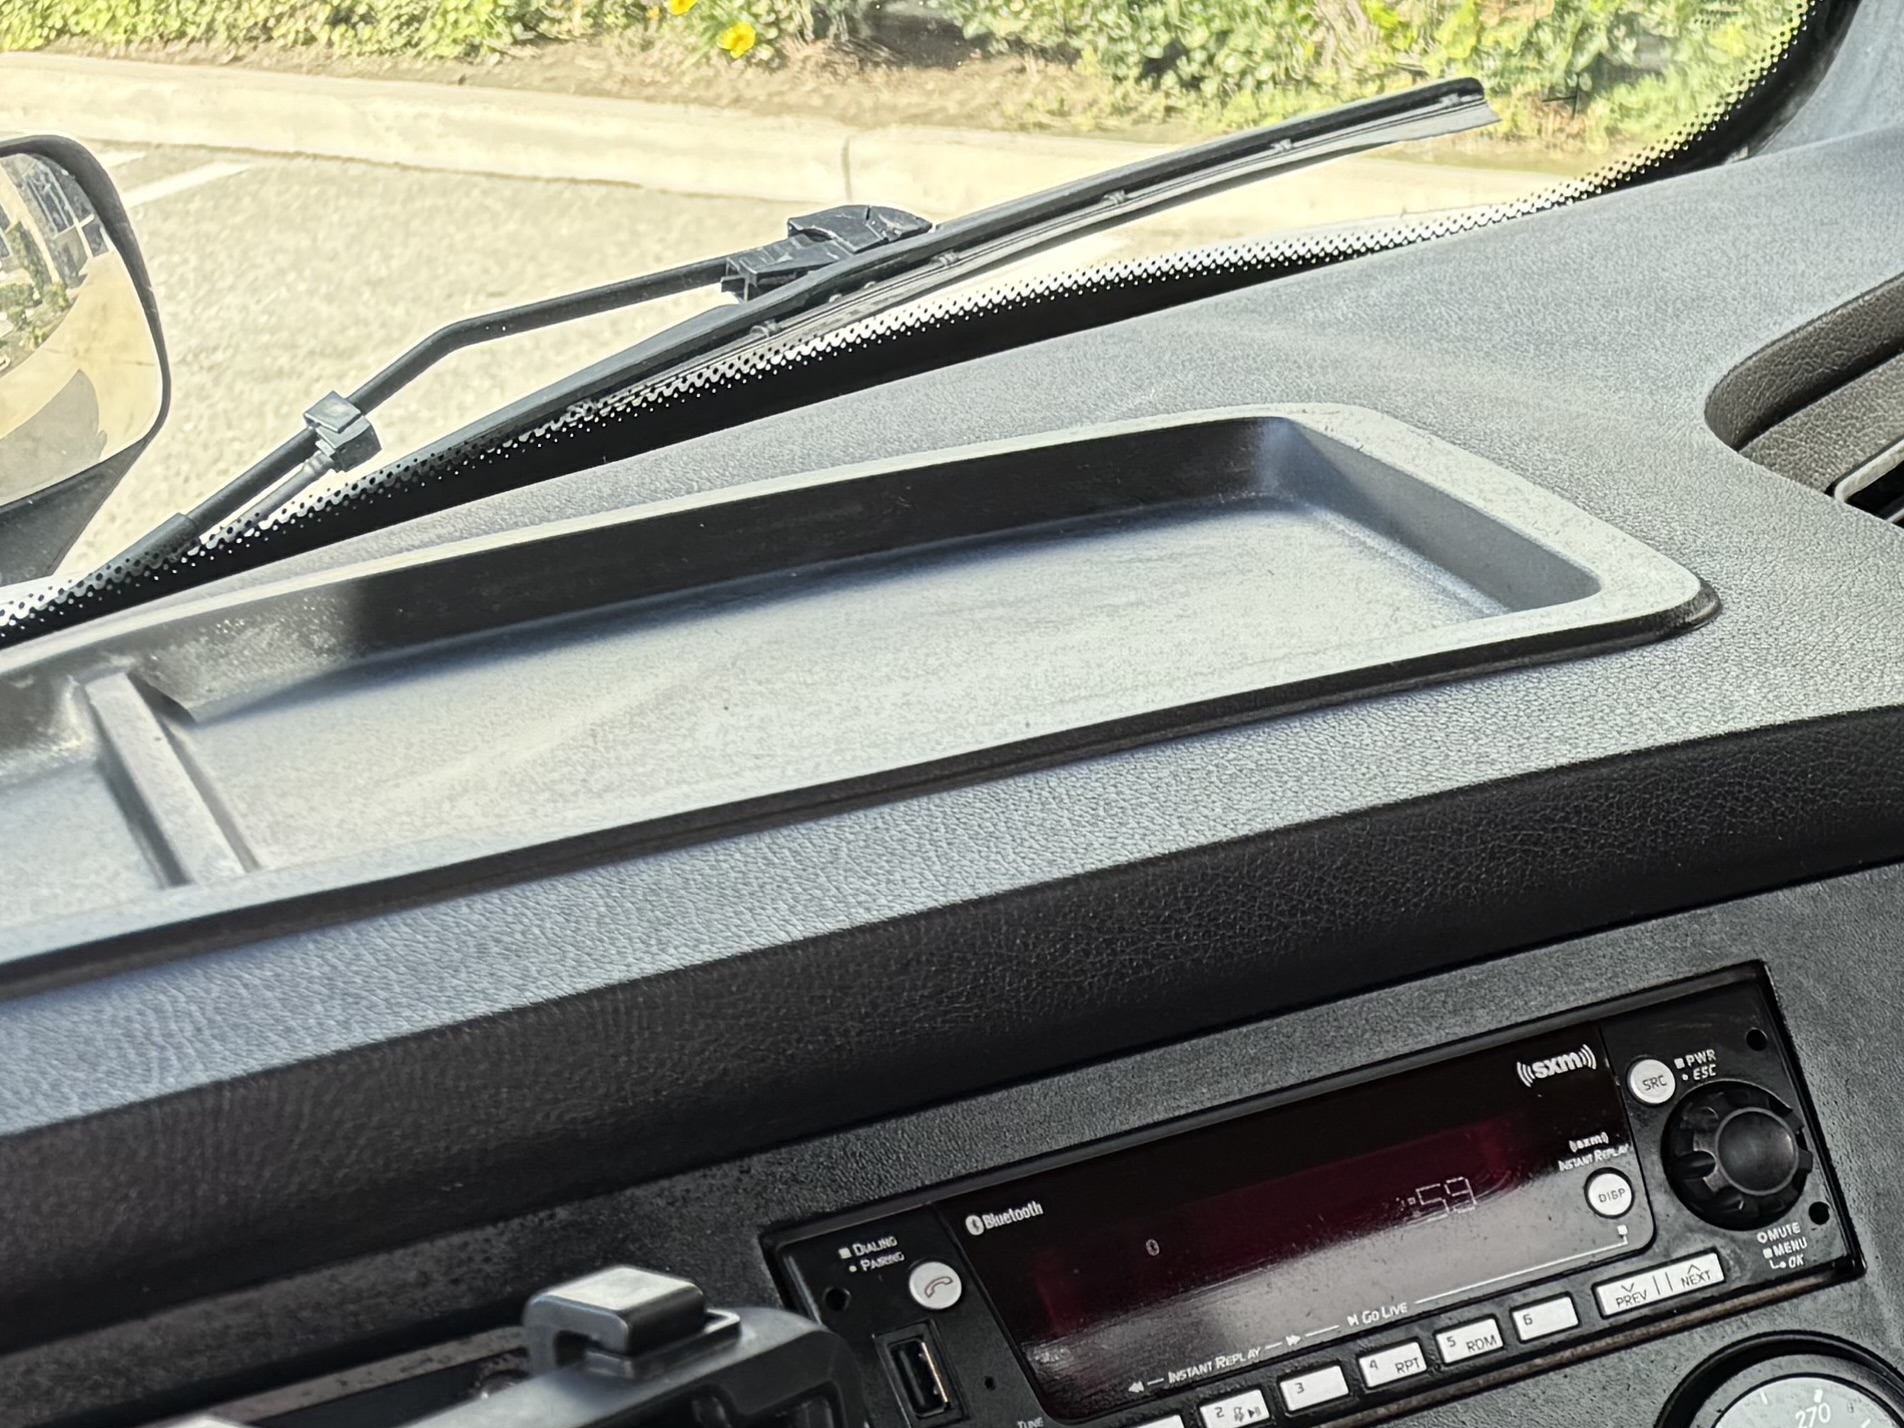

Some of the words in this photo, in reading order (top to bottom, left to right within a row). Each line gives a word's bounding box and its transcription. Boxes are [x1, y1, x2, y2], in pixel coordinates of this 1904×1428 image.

[1686, 1048, 1717, 1068] PWR
[1692, 1063, 1717, 1081] ESC
[1642, 1073, 1668, 1092] SRC
[982, 1200, 1044, 1231] Bluetooth
[1767, 1221, 1802, 1241] MUTE
[1773, 1237, 1808, 1257] MENU
[1788, 1254, 1805, 1269] OK
[1680, 1268, 1712, 1288] NEXT
[1616, 1290, 1648, 1309] PREV
[1522, 1313, 1533, 1327] 6
[1446, 1335, 1457, 1348] 5
[1464, 1334, 1498, 1354] RDM
[1368, 1359, 1379, 1372] 4
[1393, 1355, 1423, 1376] RPT
[1295, 1382, 1306, 1395] 3
[1213, 1405, 1225, 1419] 2
